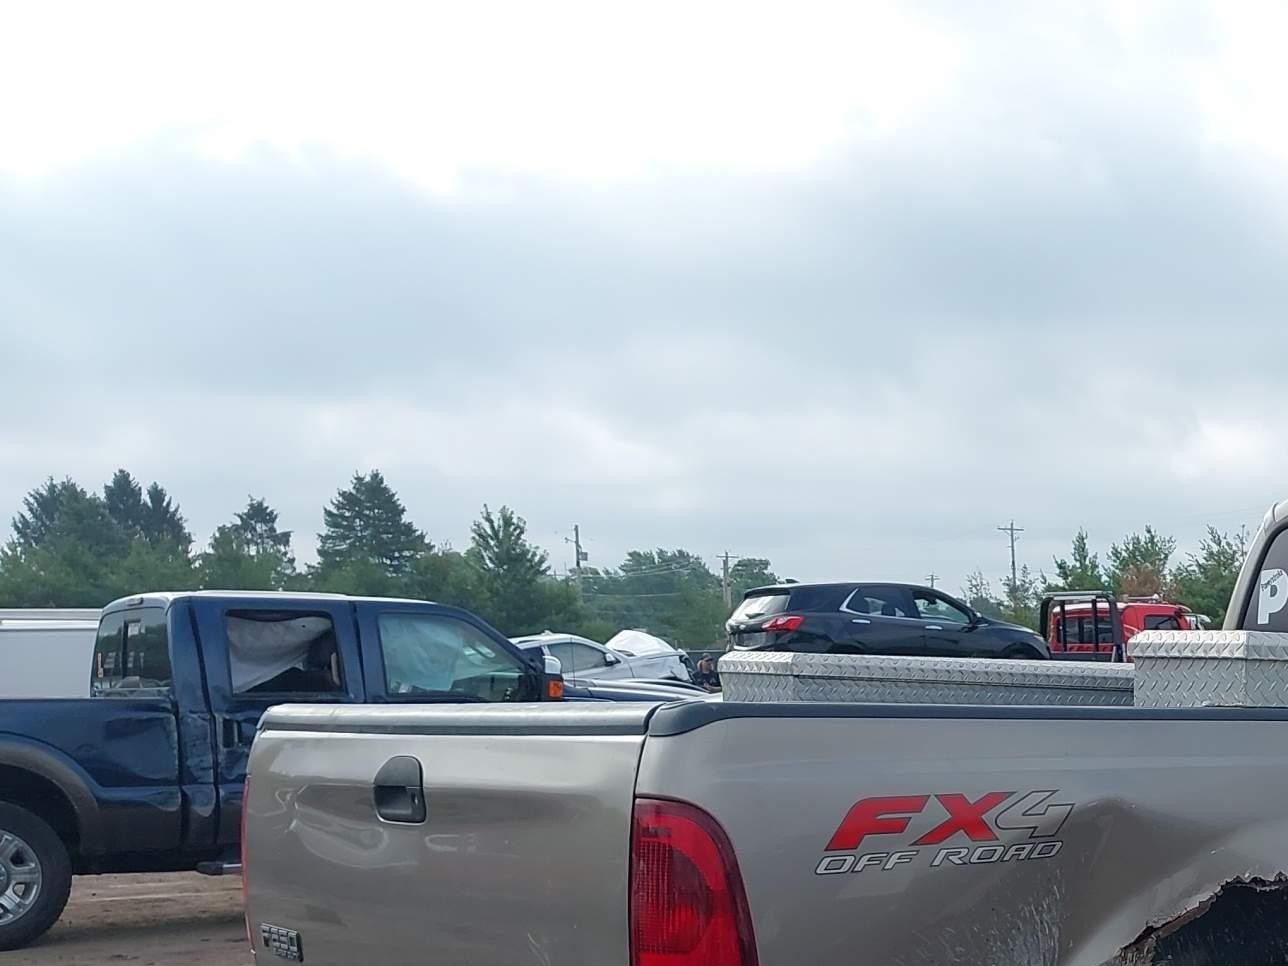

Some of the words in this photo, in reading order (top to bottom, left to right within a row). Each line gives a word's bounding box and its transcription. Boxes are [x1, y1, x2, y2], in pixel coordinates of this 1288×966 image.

[823, 789, 1076, 851] FX4
[814, 850, 920, 875] OFF
[929, 840, 1064, 868] ROAD
